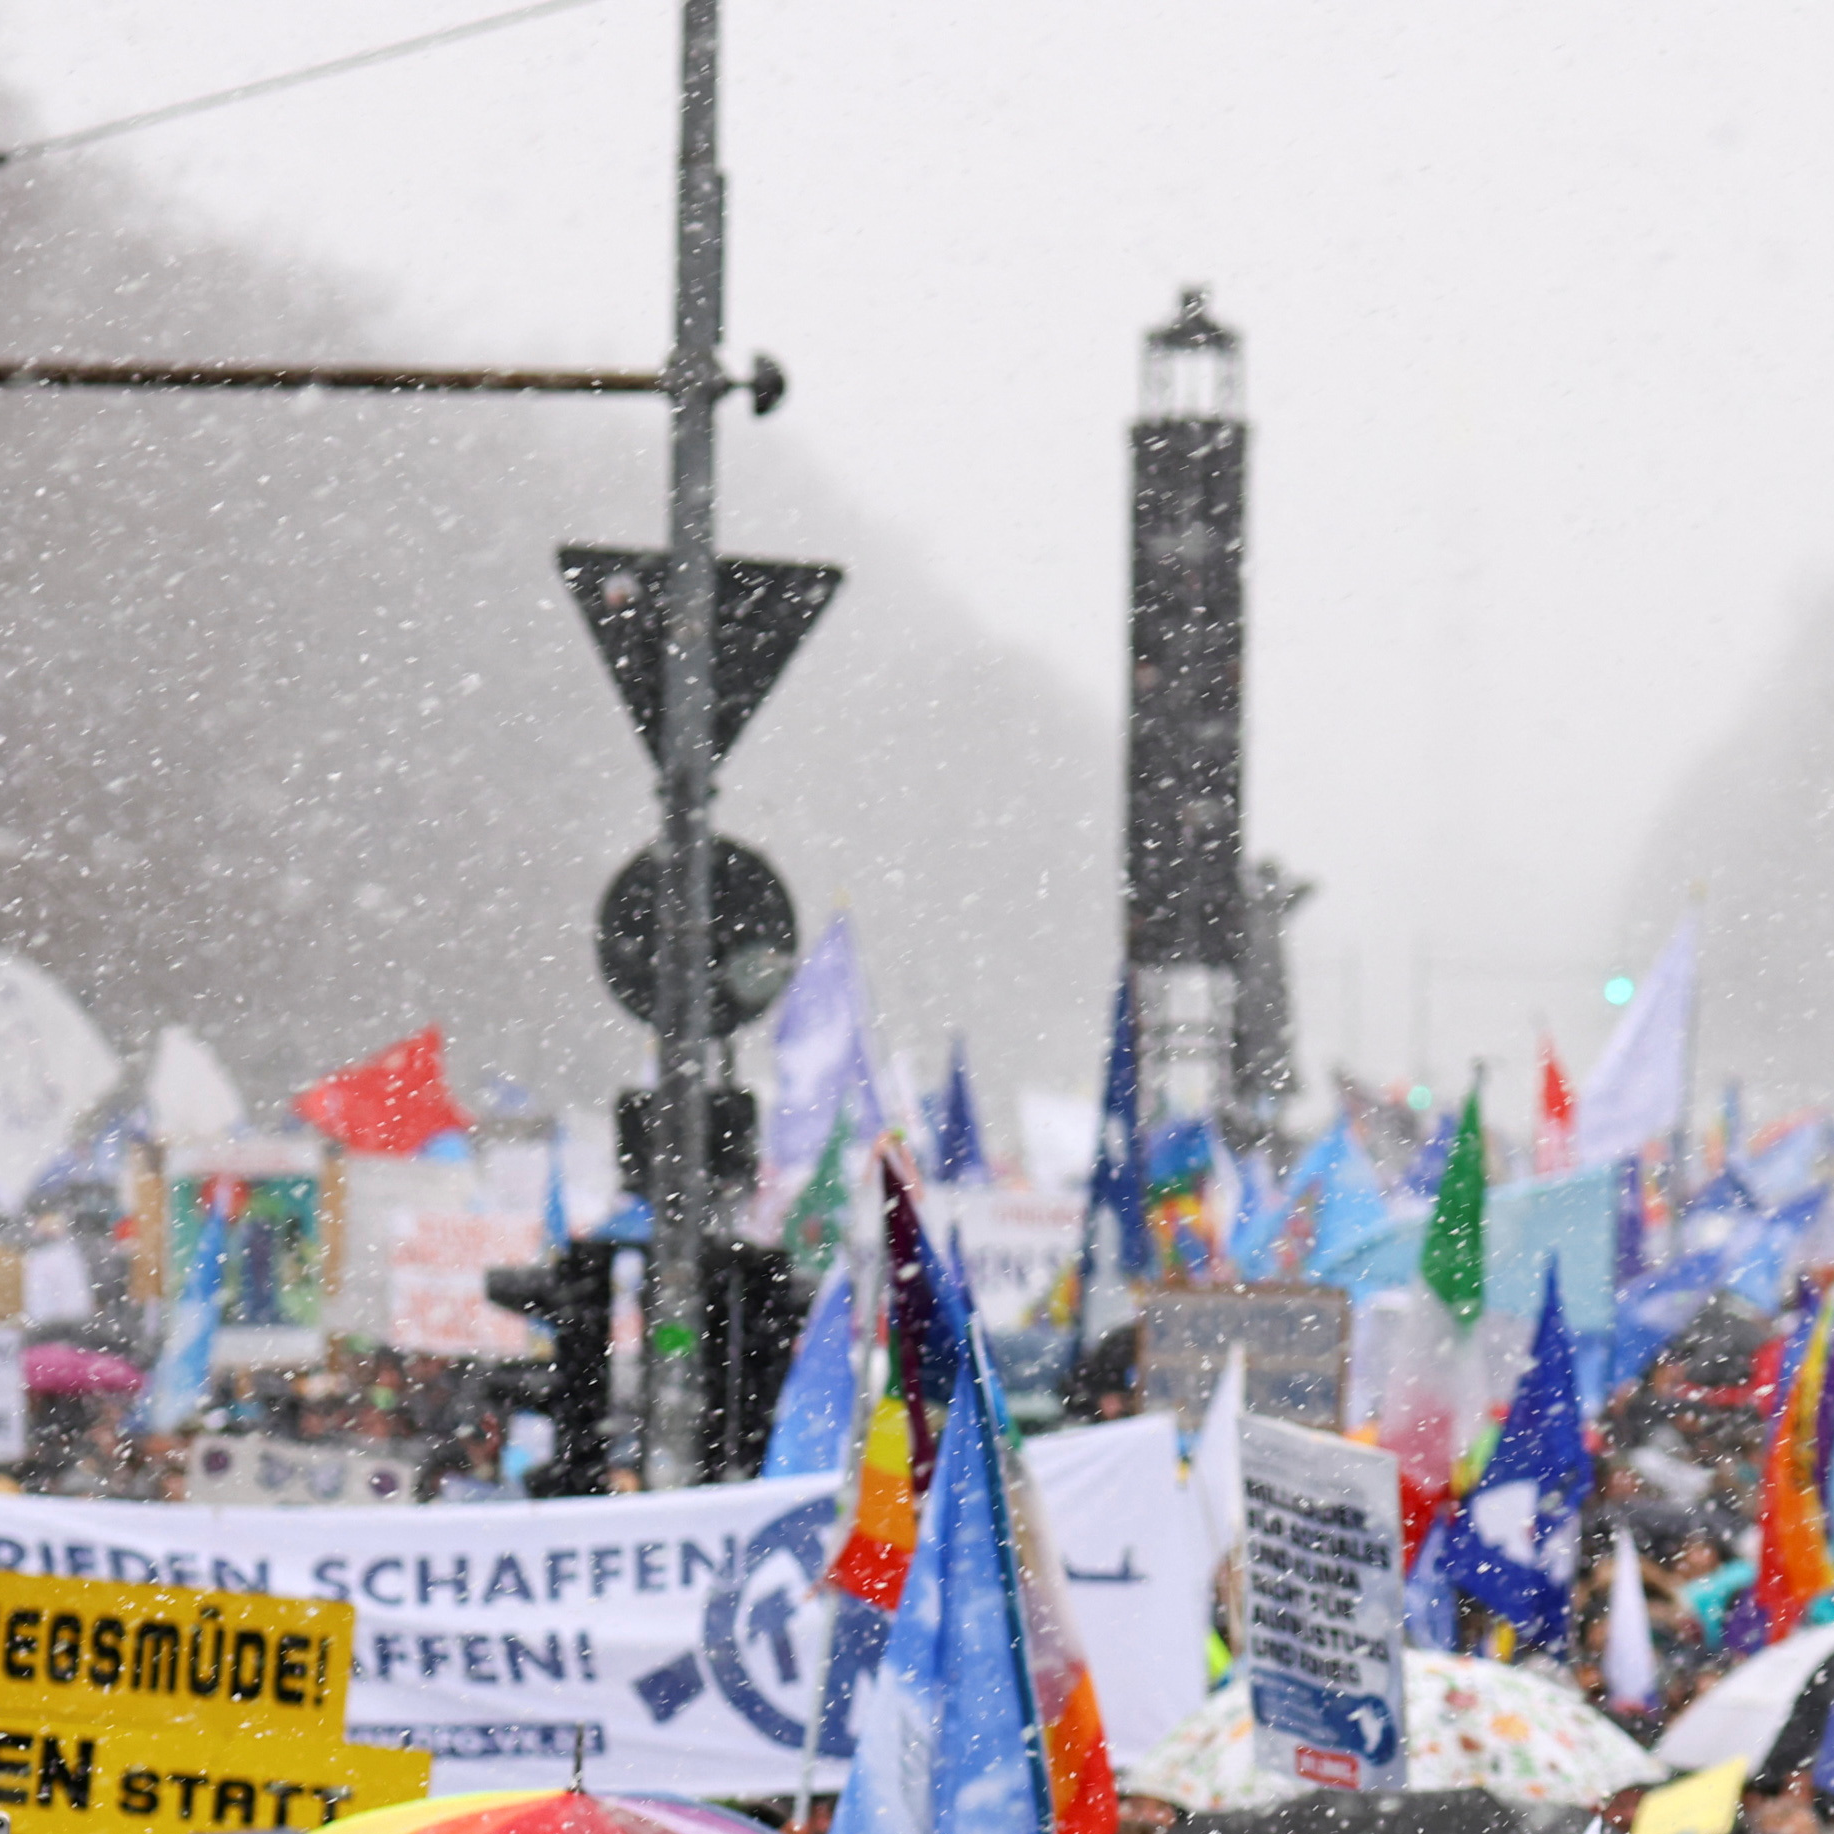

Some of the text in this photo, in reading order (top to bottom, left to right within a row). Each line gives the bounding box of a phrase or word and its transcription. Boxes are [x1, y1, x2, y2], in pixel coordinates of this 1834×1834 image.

[314, 1533, 736, 1605] SCHAFFEN
[351, 1630, 598, 1683] FFEN!
[119, 1765, 354, 1829] STATT
